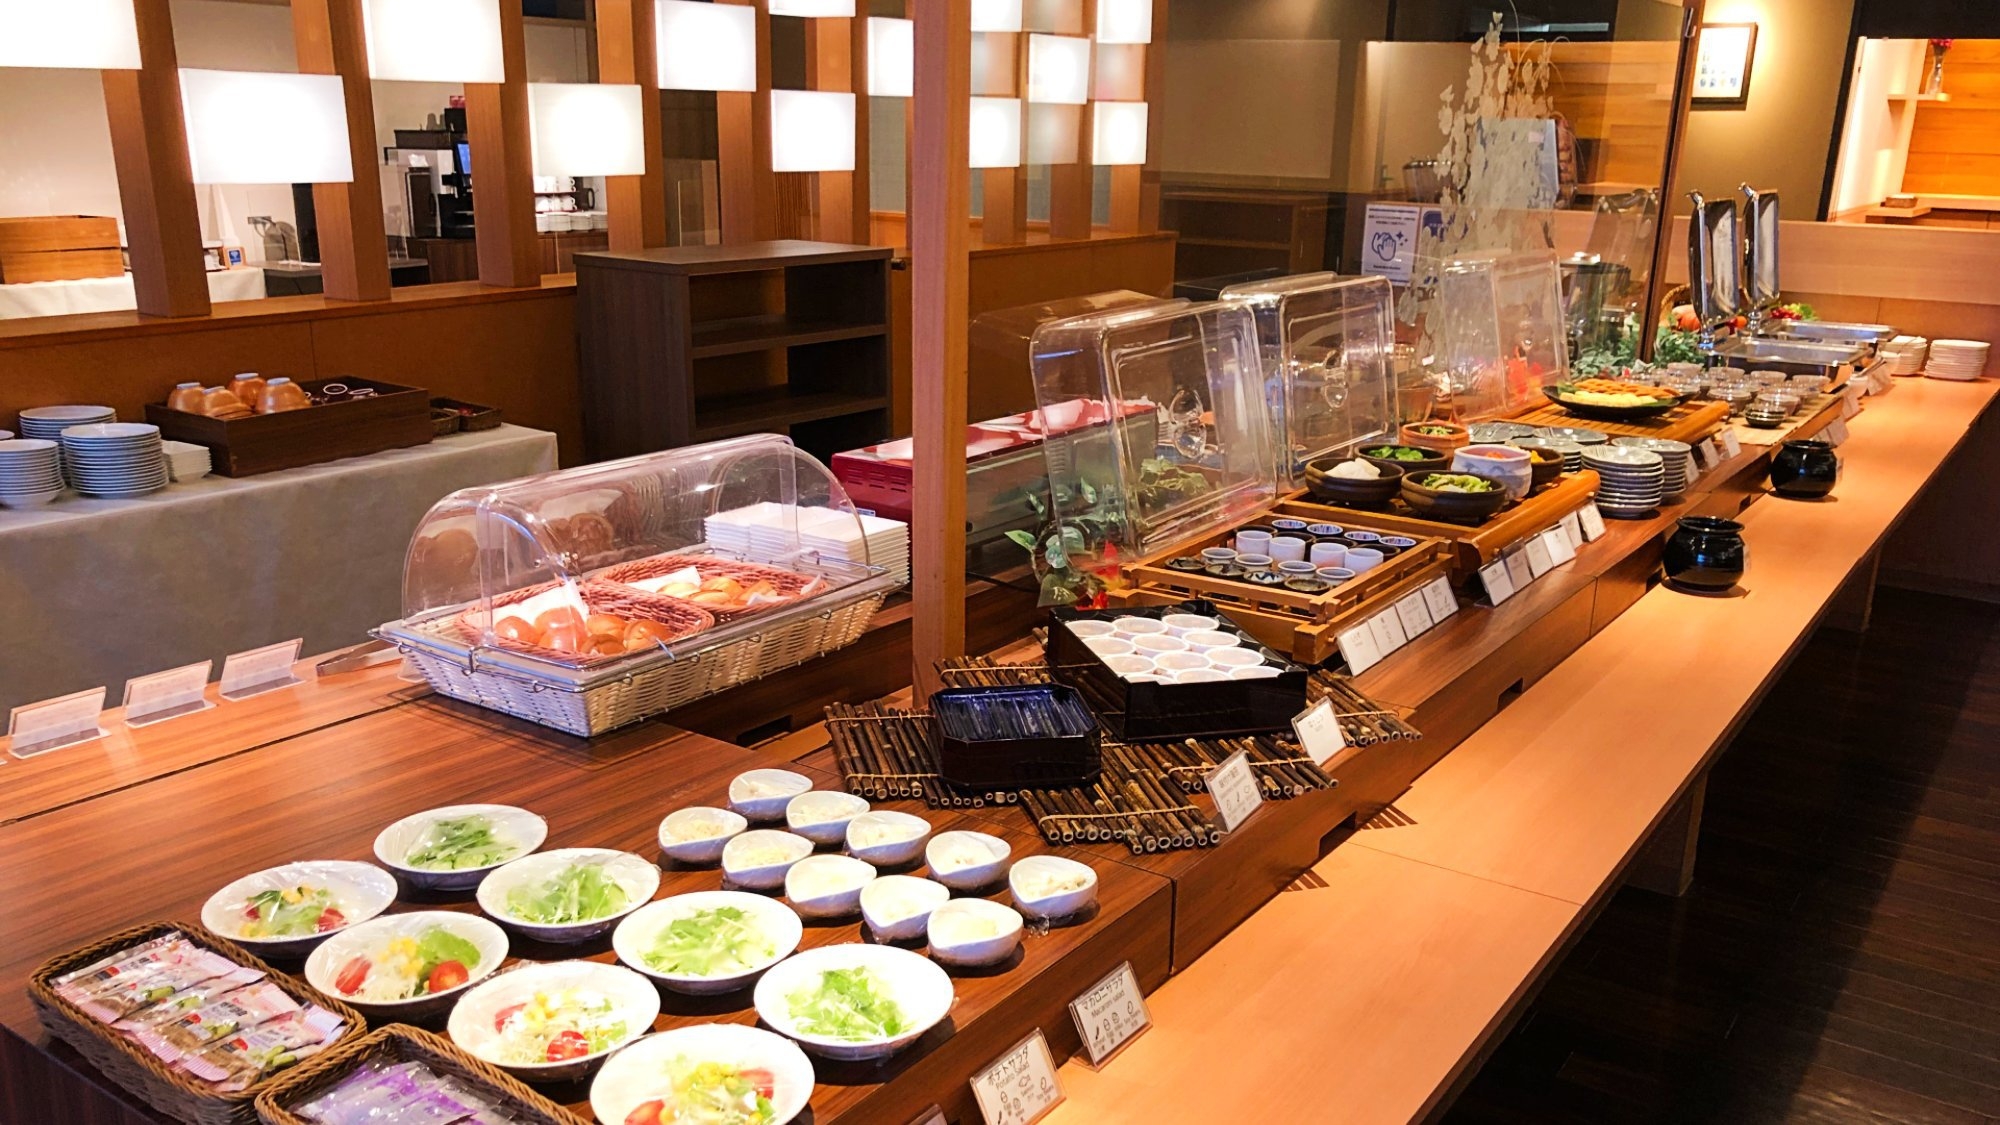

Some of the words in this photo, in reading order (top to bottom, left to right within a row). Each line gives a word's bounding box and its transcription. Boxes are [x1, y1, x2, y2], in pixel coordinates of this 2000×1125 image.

[1082, 972, 1123, 1010] マカロニサラダ
[987, 1044, 1028, 1086] ポテトサラダ
